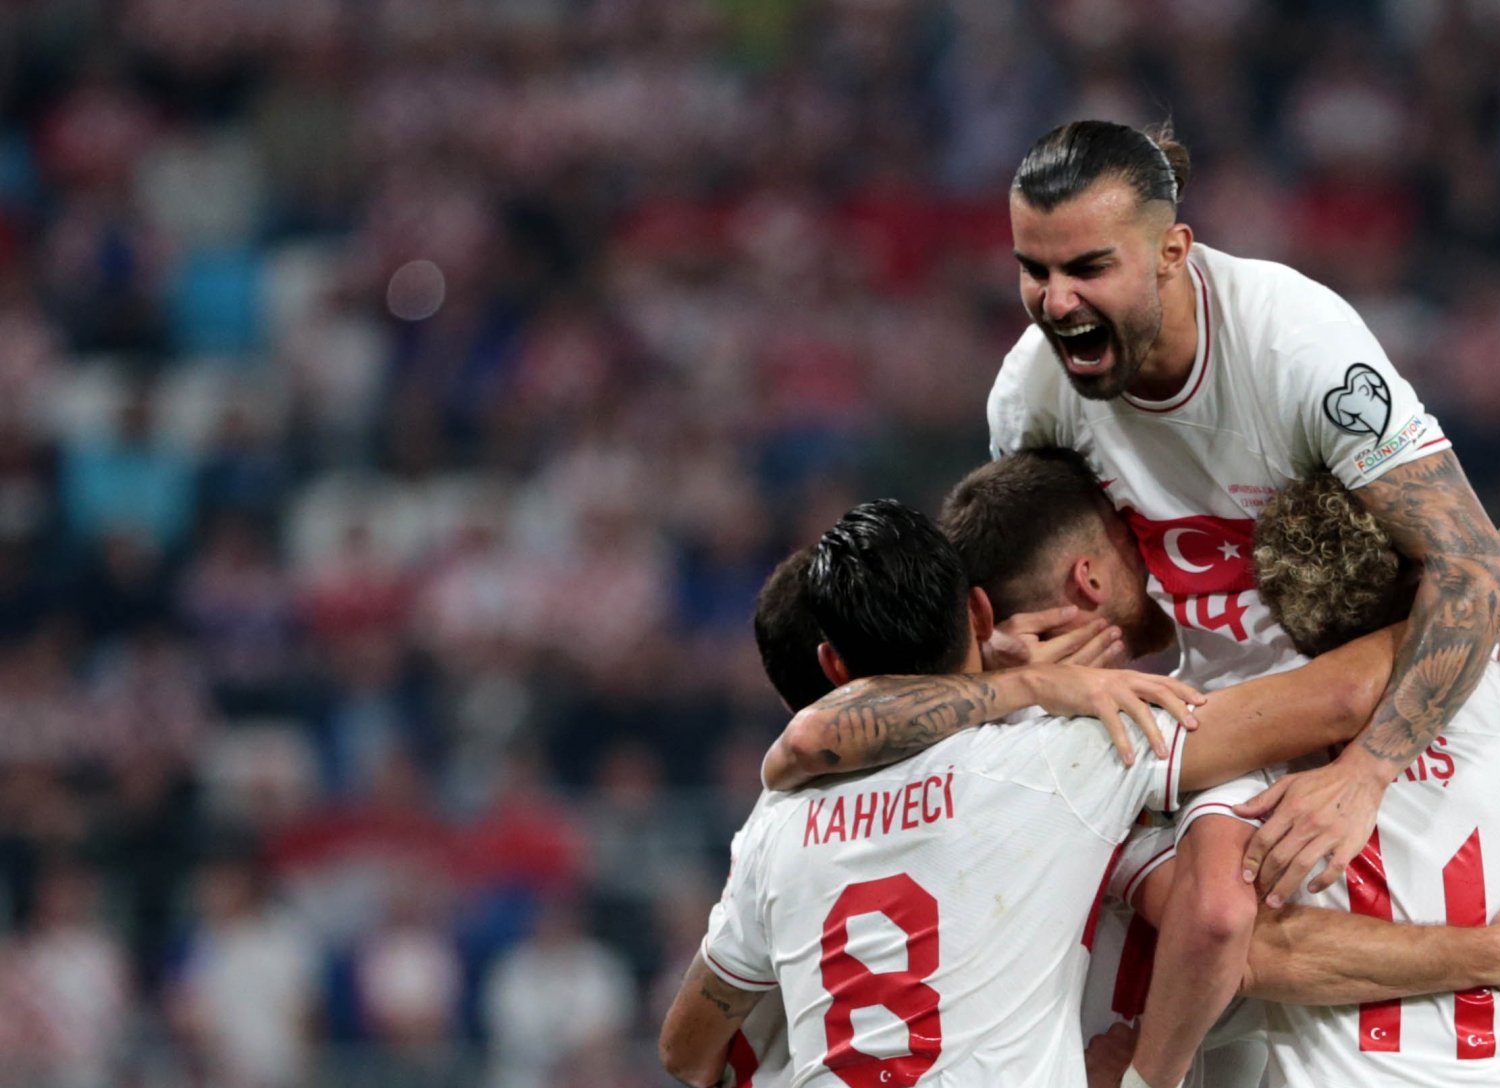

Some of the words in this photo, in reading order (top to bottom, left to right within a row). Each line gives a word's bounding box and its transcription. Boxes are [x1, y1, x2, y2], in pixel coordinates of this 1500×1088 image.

[1357, 419, 1422, 471] FOUNDATION
[1173, 593, 1249, 642] 14
[803, 765, 954, 848] KAHVECİ
